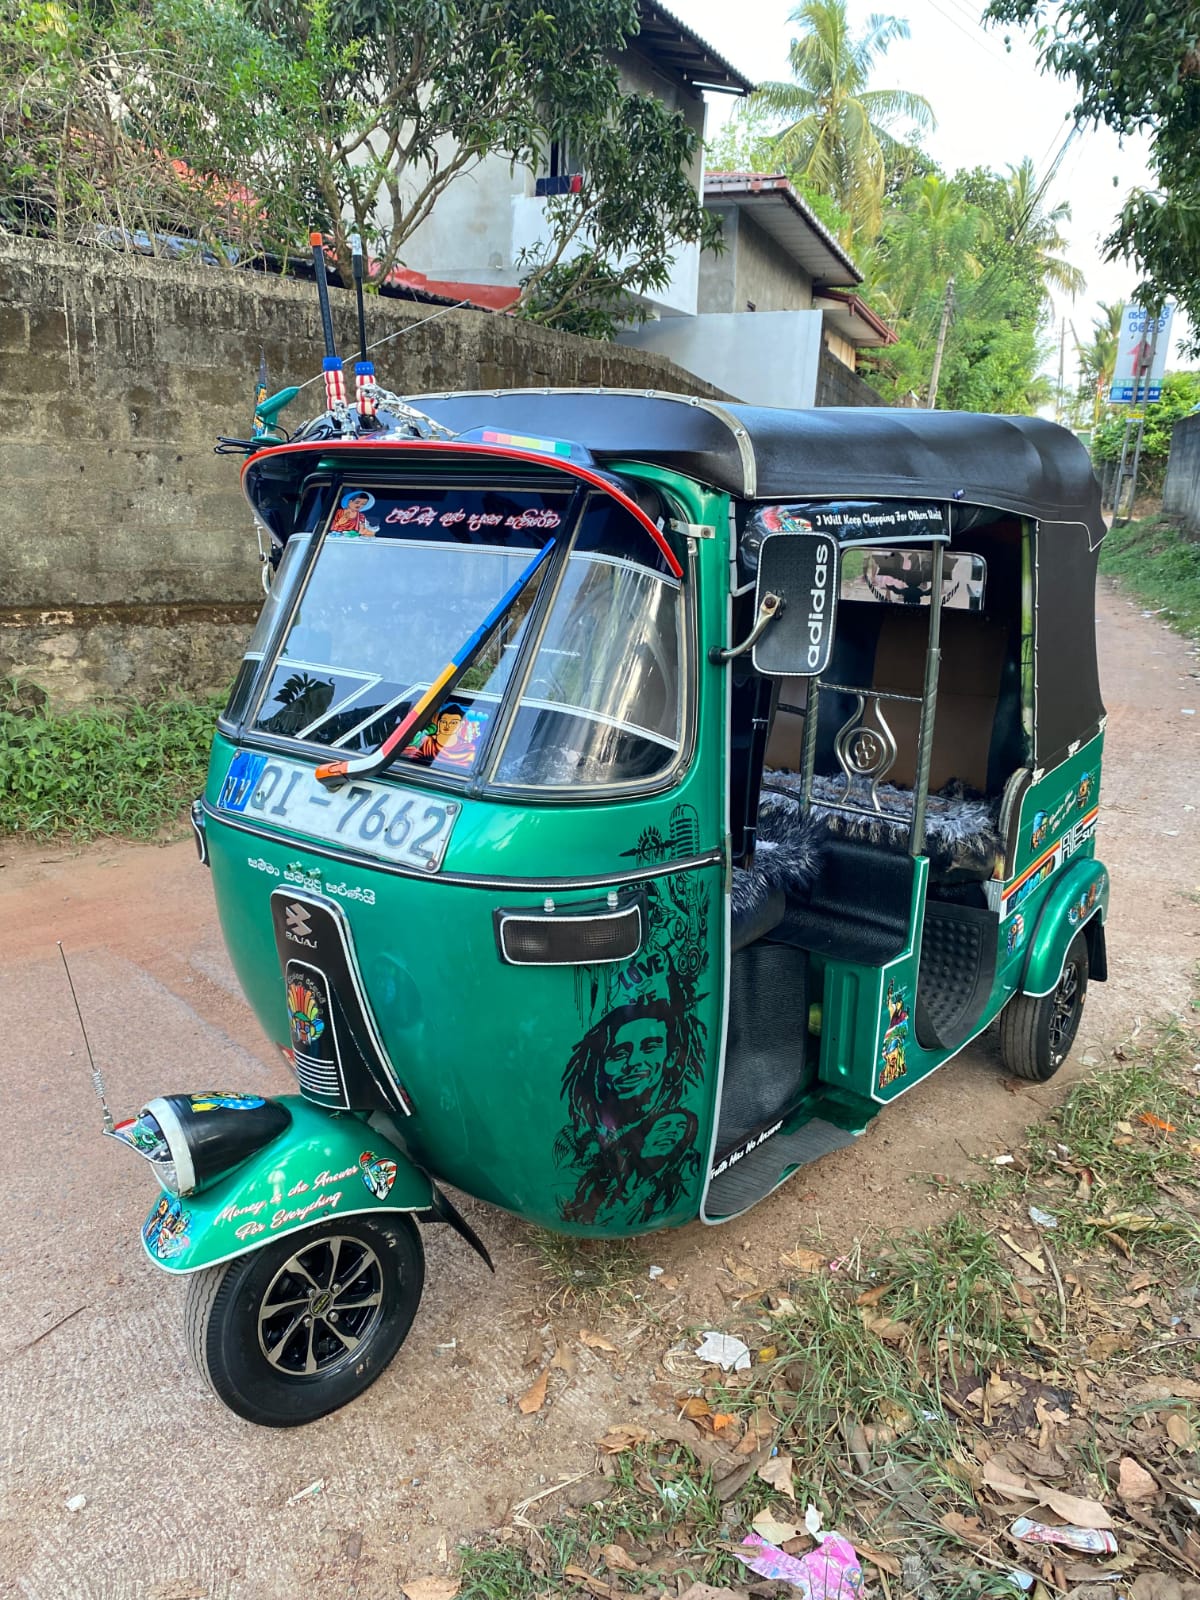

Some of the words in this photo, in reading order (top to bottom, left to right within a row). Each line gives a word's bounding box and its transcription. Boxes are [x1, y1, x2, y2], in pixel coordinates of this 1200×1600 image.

[822, 514, 842, 526] Will
[843, 514, 861, 526] Keep
[862, 512, 896, 526] Clapping
[895, 510, 907, 522] For
[807, 544, 829, 668] adidas
[285, 931, 318, 949] BAJAJ
[618, 953, 665, 990] LOVE
[745, 1140, 756, 1154] No
[213, 1199, 267, 1226] Money
[288, 1180, 310, 1197] the
[312, 1165, 359, 1191] Answer
[234, 1221, 266, 1240] For
[270, 1192, 343, 1229] Everything
